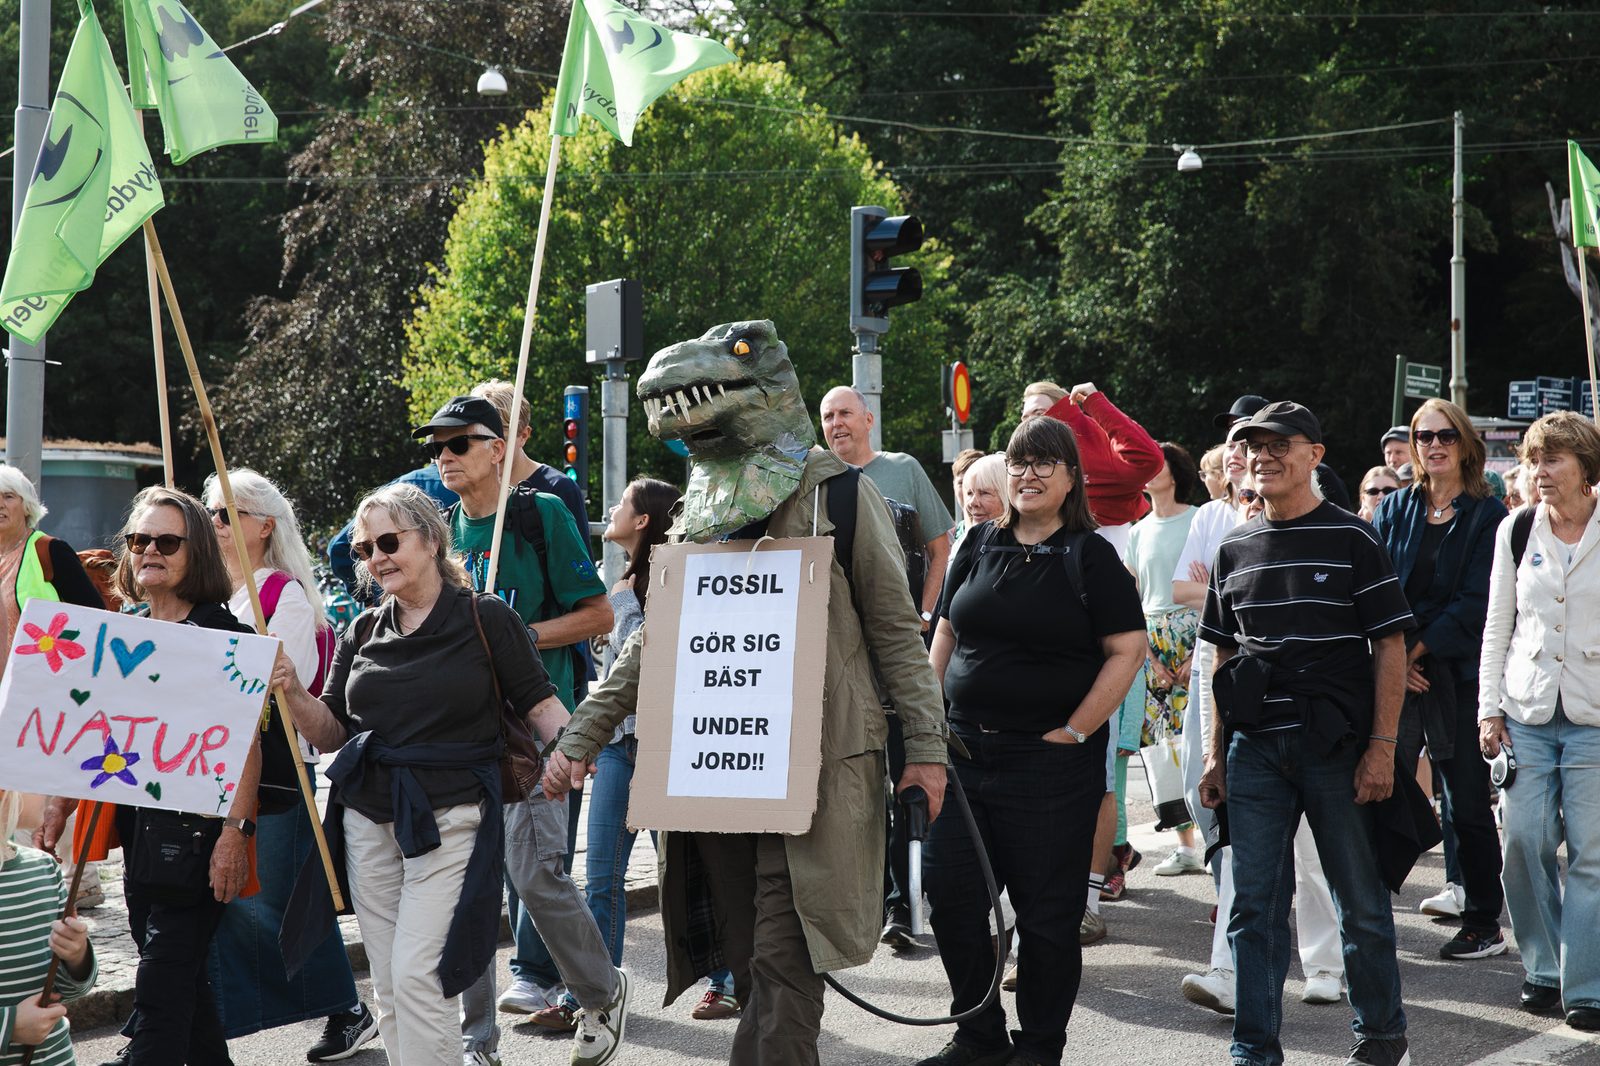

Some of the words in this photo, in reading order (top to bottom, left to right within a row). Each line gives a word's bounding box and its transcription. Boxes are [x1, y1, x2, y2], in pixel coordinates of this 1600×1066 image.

[696, 573, 784, 596] FOSSIL
[92, 622, 107, 677] I
[689, 631, 736, 653] GÖR
[742, 633, 781, 652] SIG
[703, 665, 762, 688] BÄST
[692, 716, 769, 736] UNDER
[16, 706, 230, 776] NATUR
[691, 751, 765, 771] JORD!!
